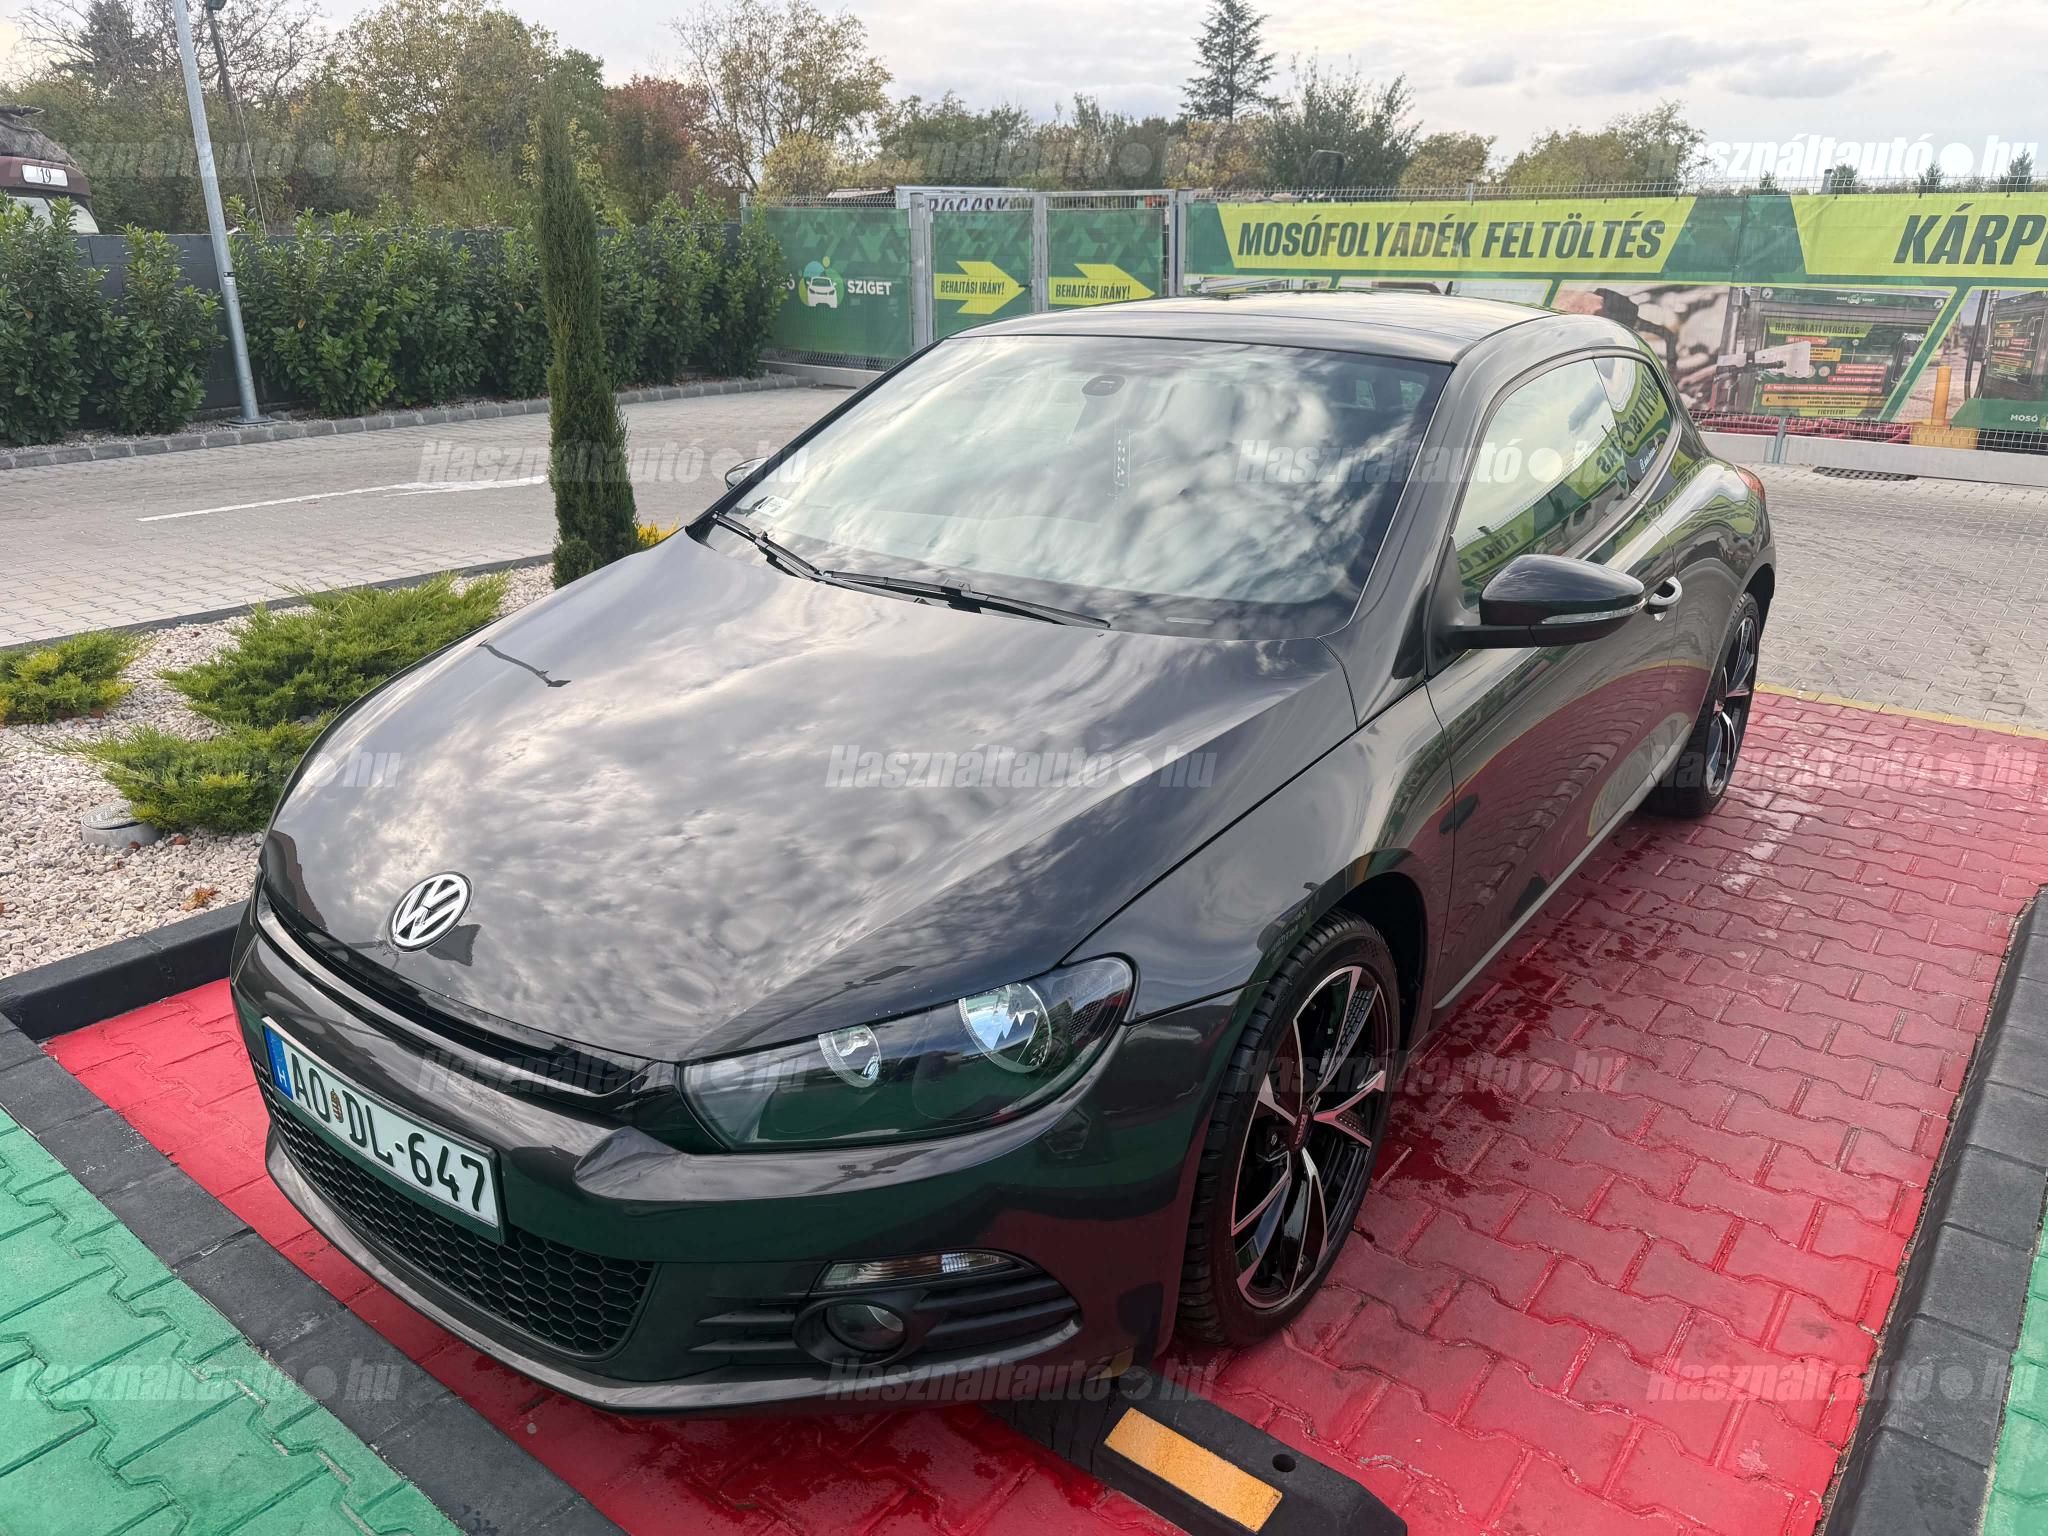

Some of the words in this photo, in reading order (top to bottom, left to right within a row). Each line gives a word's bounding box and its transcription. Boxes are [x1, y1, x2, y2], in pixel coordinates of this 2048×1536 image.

[39, 167, 51, 183] 19
[1237, 213, 1479, 258] MOSÓFOLYADÉK
[1481, 210, 1666, 259] FELTÖLTÉS
[847, 280, 892, 295] SZIGET
[940, 279, 978, 295] BEHAJTÁSI
[979, 279, 1005, 296] IRÁNY!
[1055, 283, 1099, 298] BEHAJTÁSI
[1100, 284, 1131, 300] IRÁNY!
[2010, 414, 2039, 423] MOSÓ
[291, 1053, 331, 1123] AO
[342, 1090, 486, 1212] DL-647
